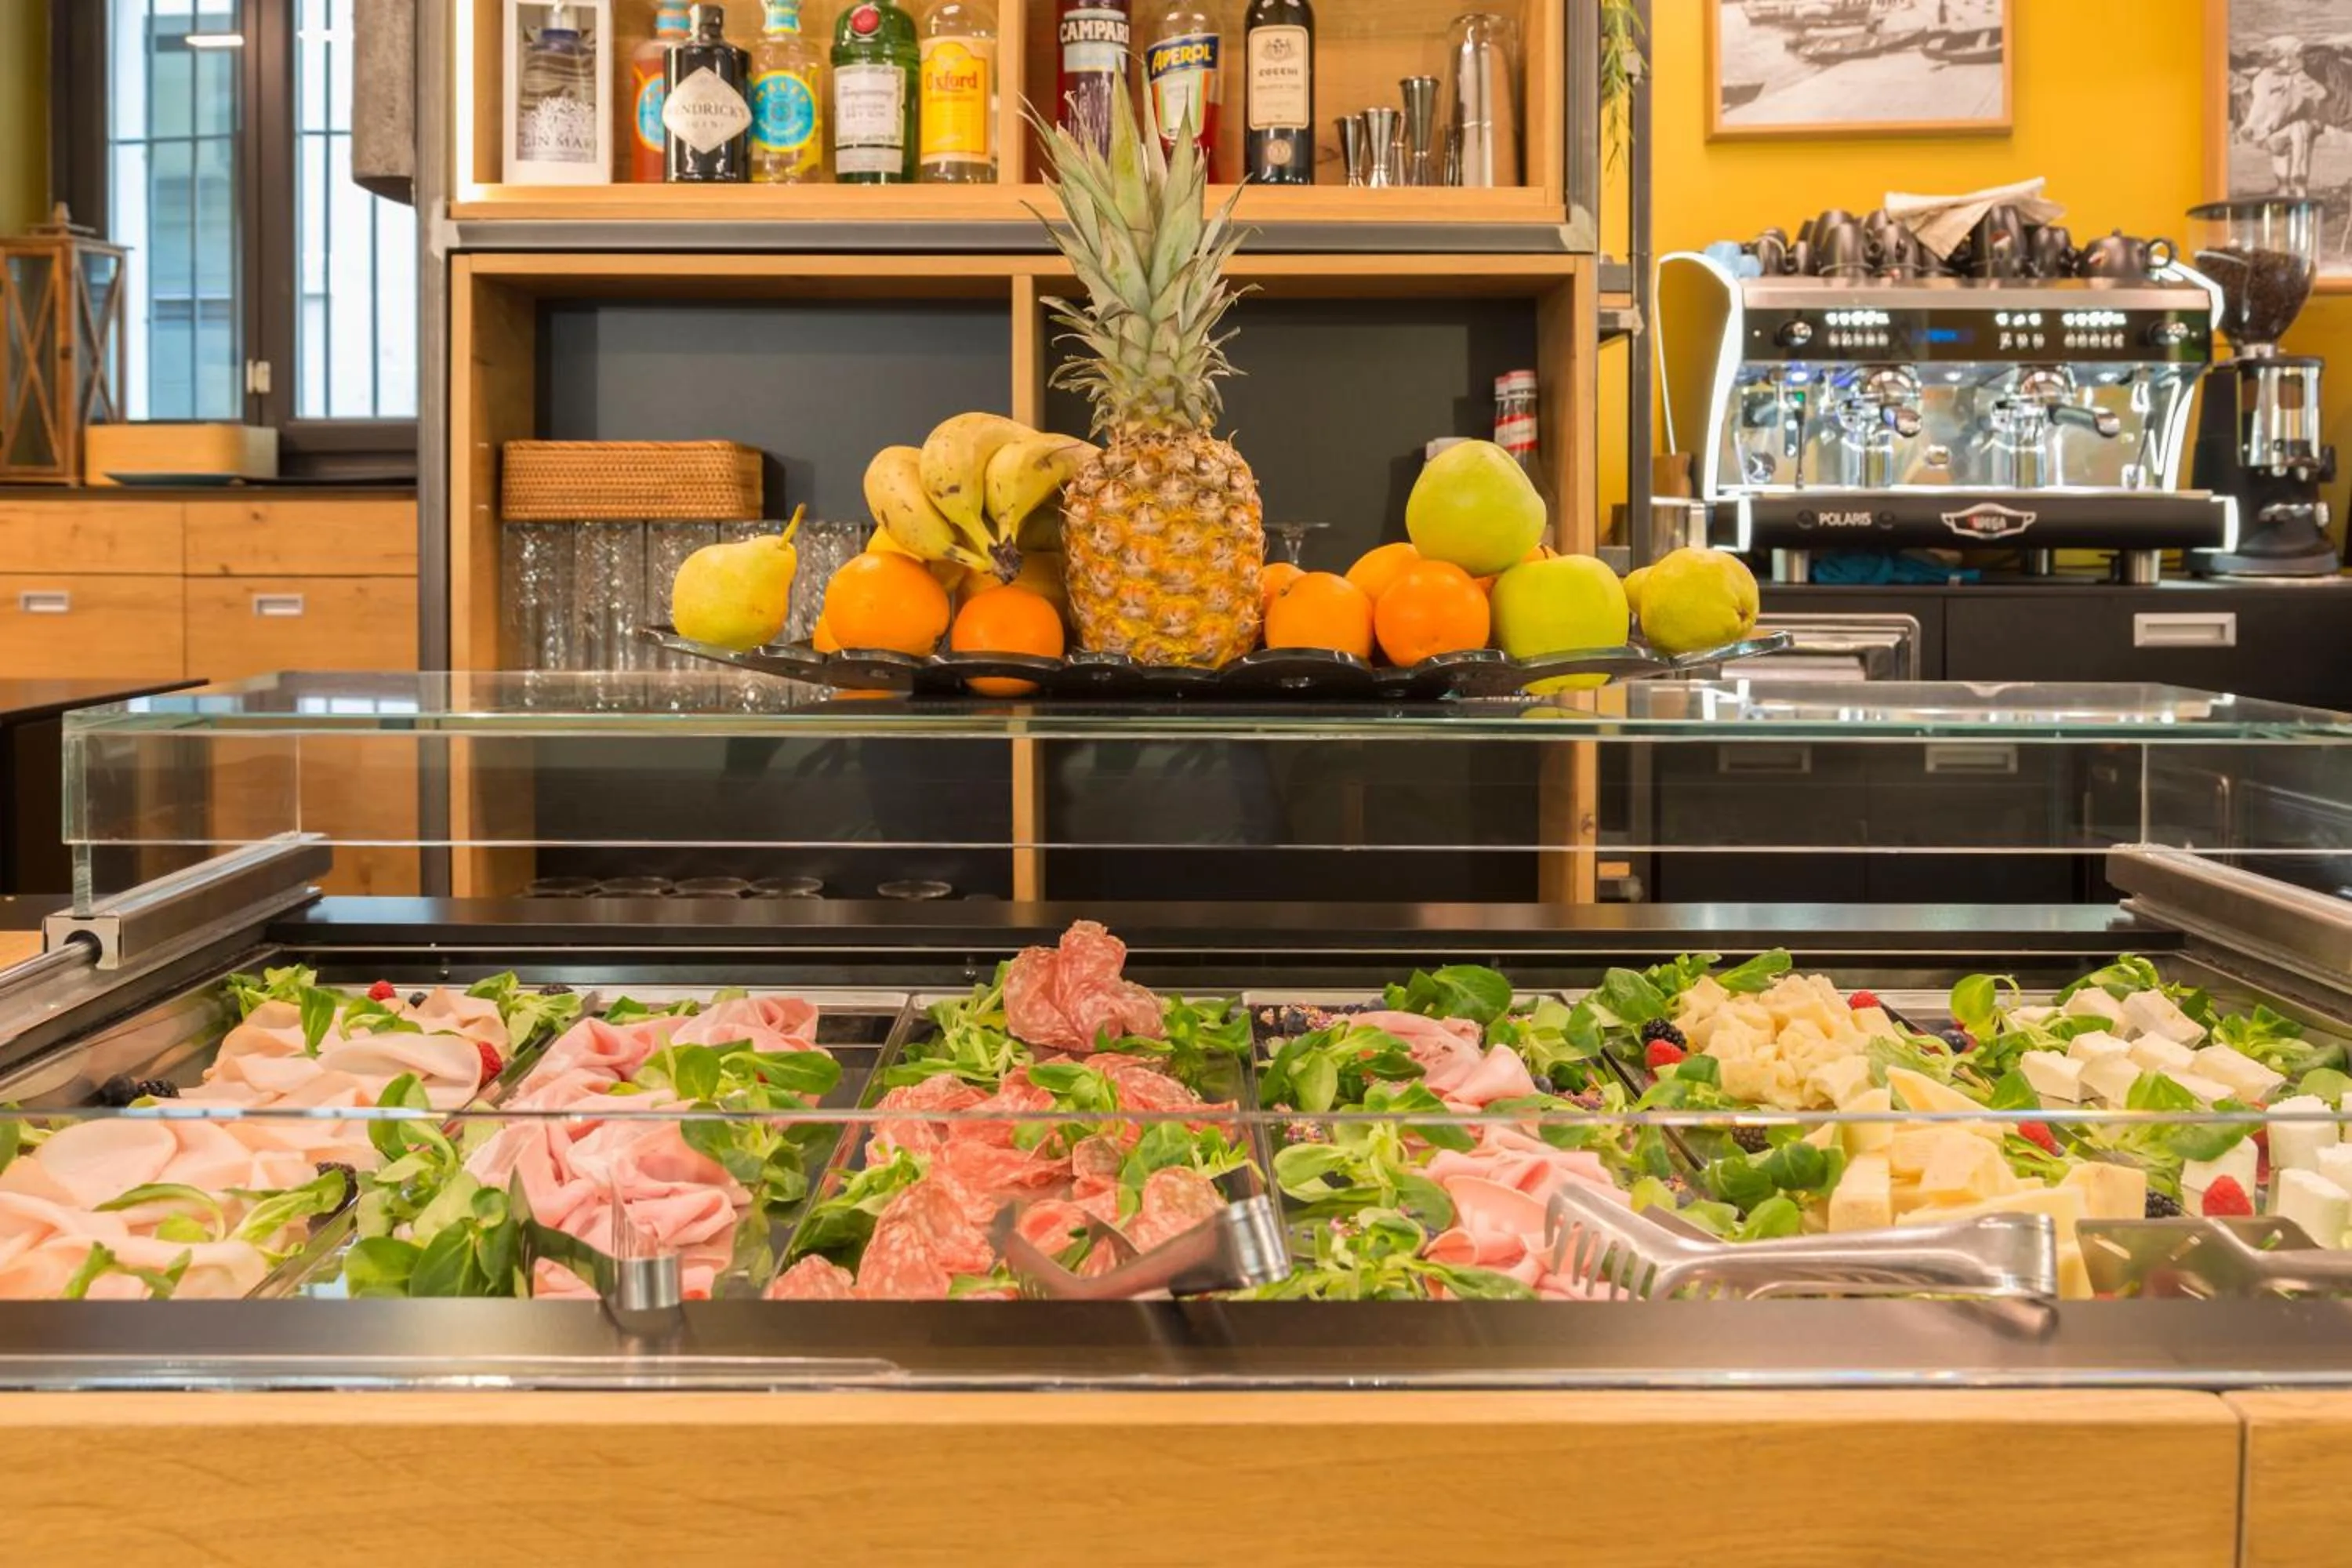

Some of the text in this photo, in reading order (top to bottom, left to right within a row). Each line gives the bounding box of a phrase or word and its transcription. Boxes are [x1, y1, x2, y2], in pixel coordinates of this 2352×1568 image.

[1059, 20, 1129, 45] CAMPARI
[1152, 43, 1212, 75] APEROL
[1819, 512, 1871, 526] POLARIS
